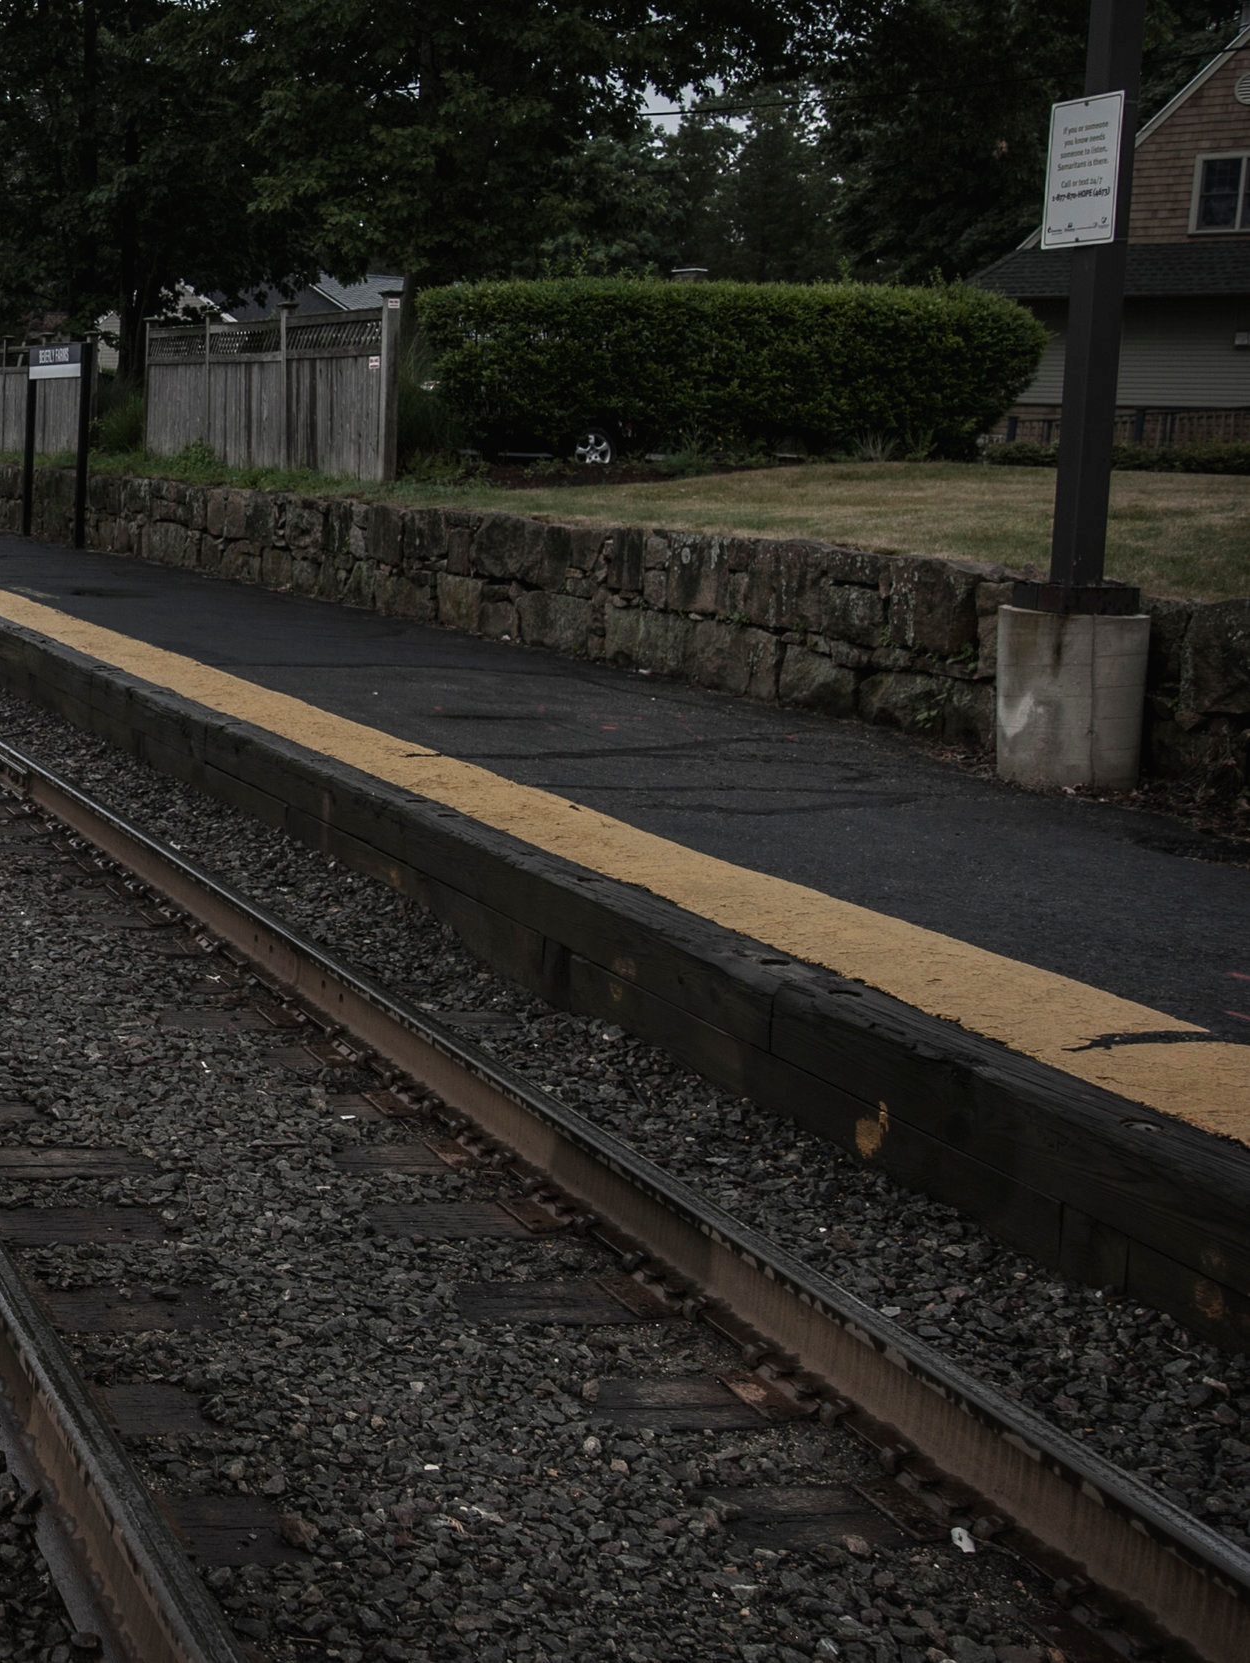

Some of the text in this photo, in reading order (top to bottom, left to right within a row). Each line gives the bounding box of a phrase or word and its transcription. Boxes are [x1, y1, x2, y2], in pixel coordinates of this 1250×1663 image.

[1068, 126, 1078, 135] you
[1085, 121, 1109, 132] someone
[1064, 133, 1106, 148] you know needs
[1060, 149, 1084, 159] someone
[1057, 160, 1087, 171] Samaritans
[1061, 179, 1071, 188] Call
[1078, 178, 1089, 186] text
